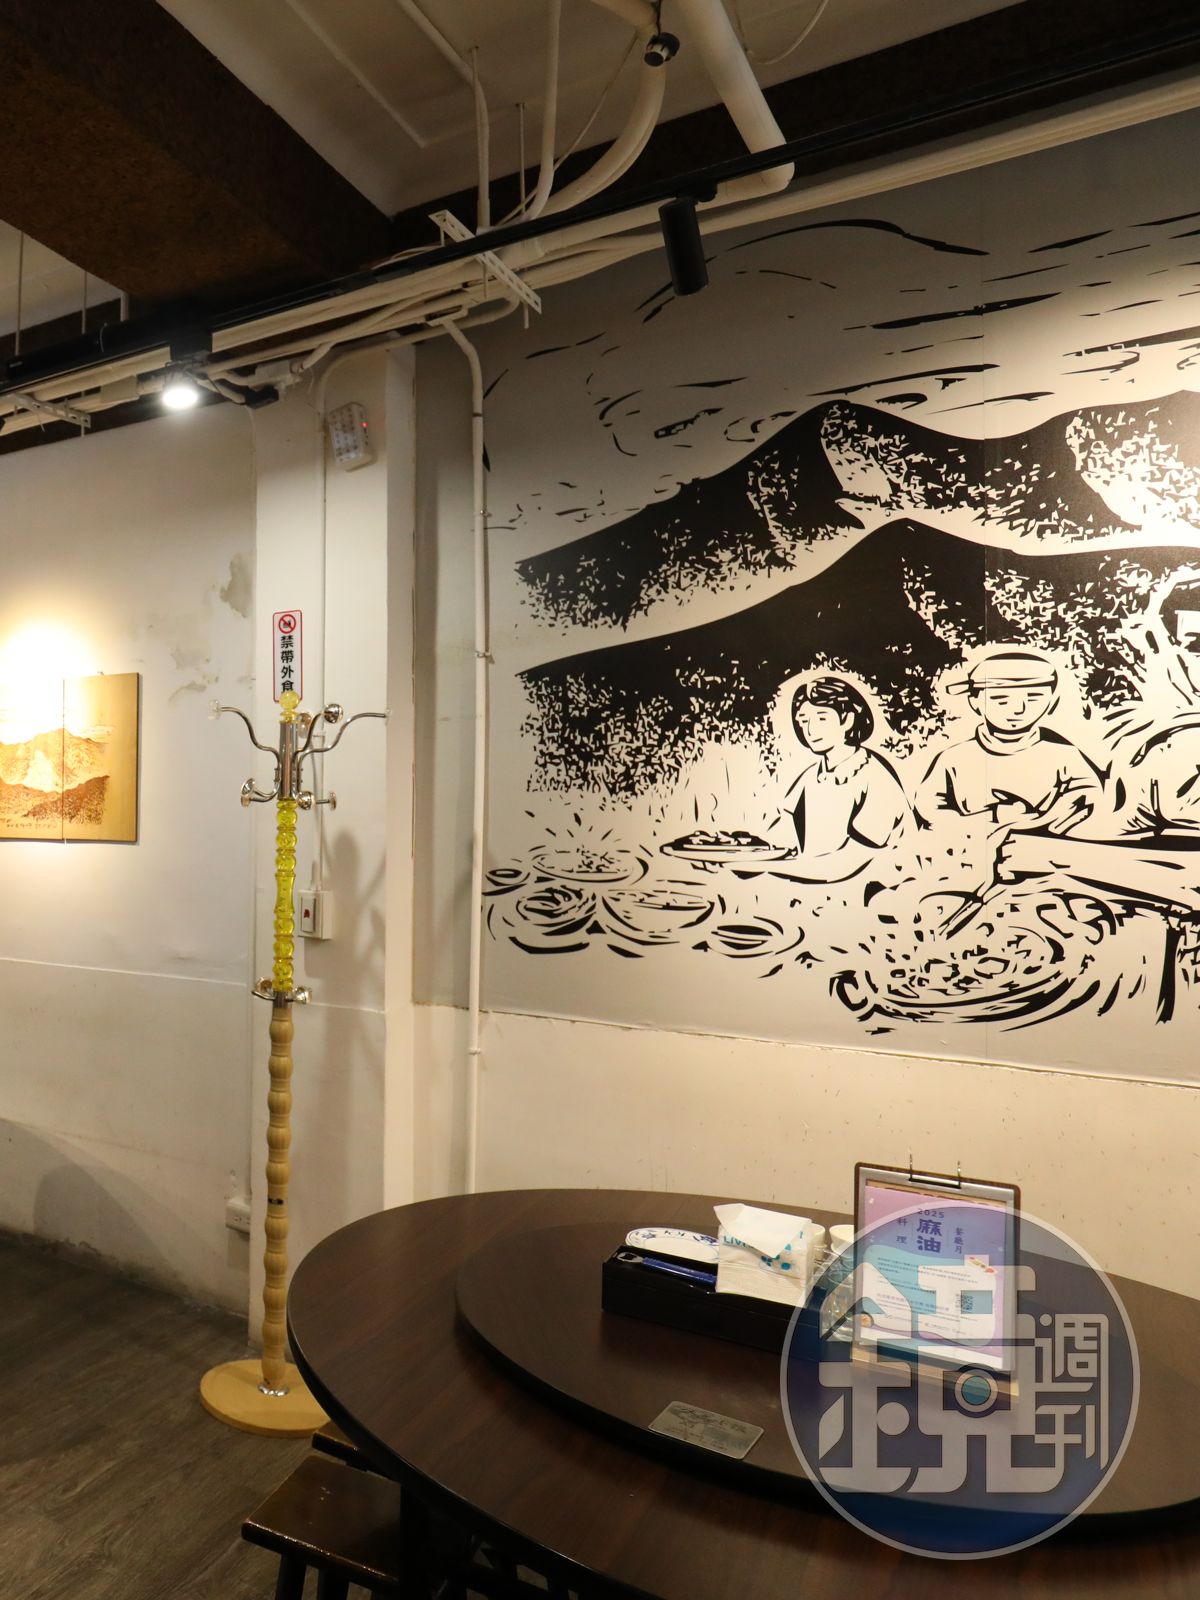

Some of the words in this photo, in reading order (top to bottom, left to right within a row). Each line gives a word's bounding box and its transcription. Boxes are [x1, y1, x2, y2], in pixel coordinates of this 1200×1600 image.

[280, 635, 294, 693] 禁帶外食
[917, 1208, 945, 1219] 2025
[916, 1219, 943, 1254] 麻油
